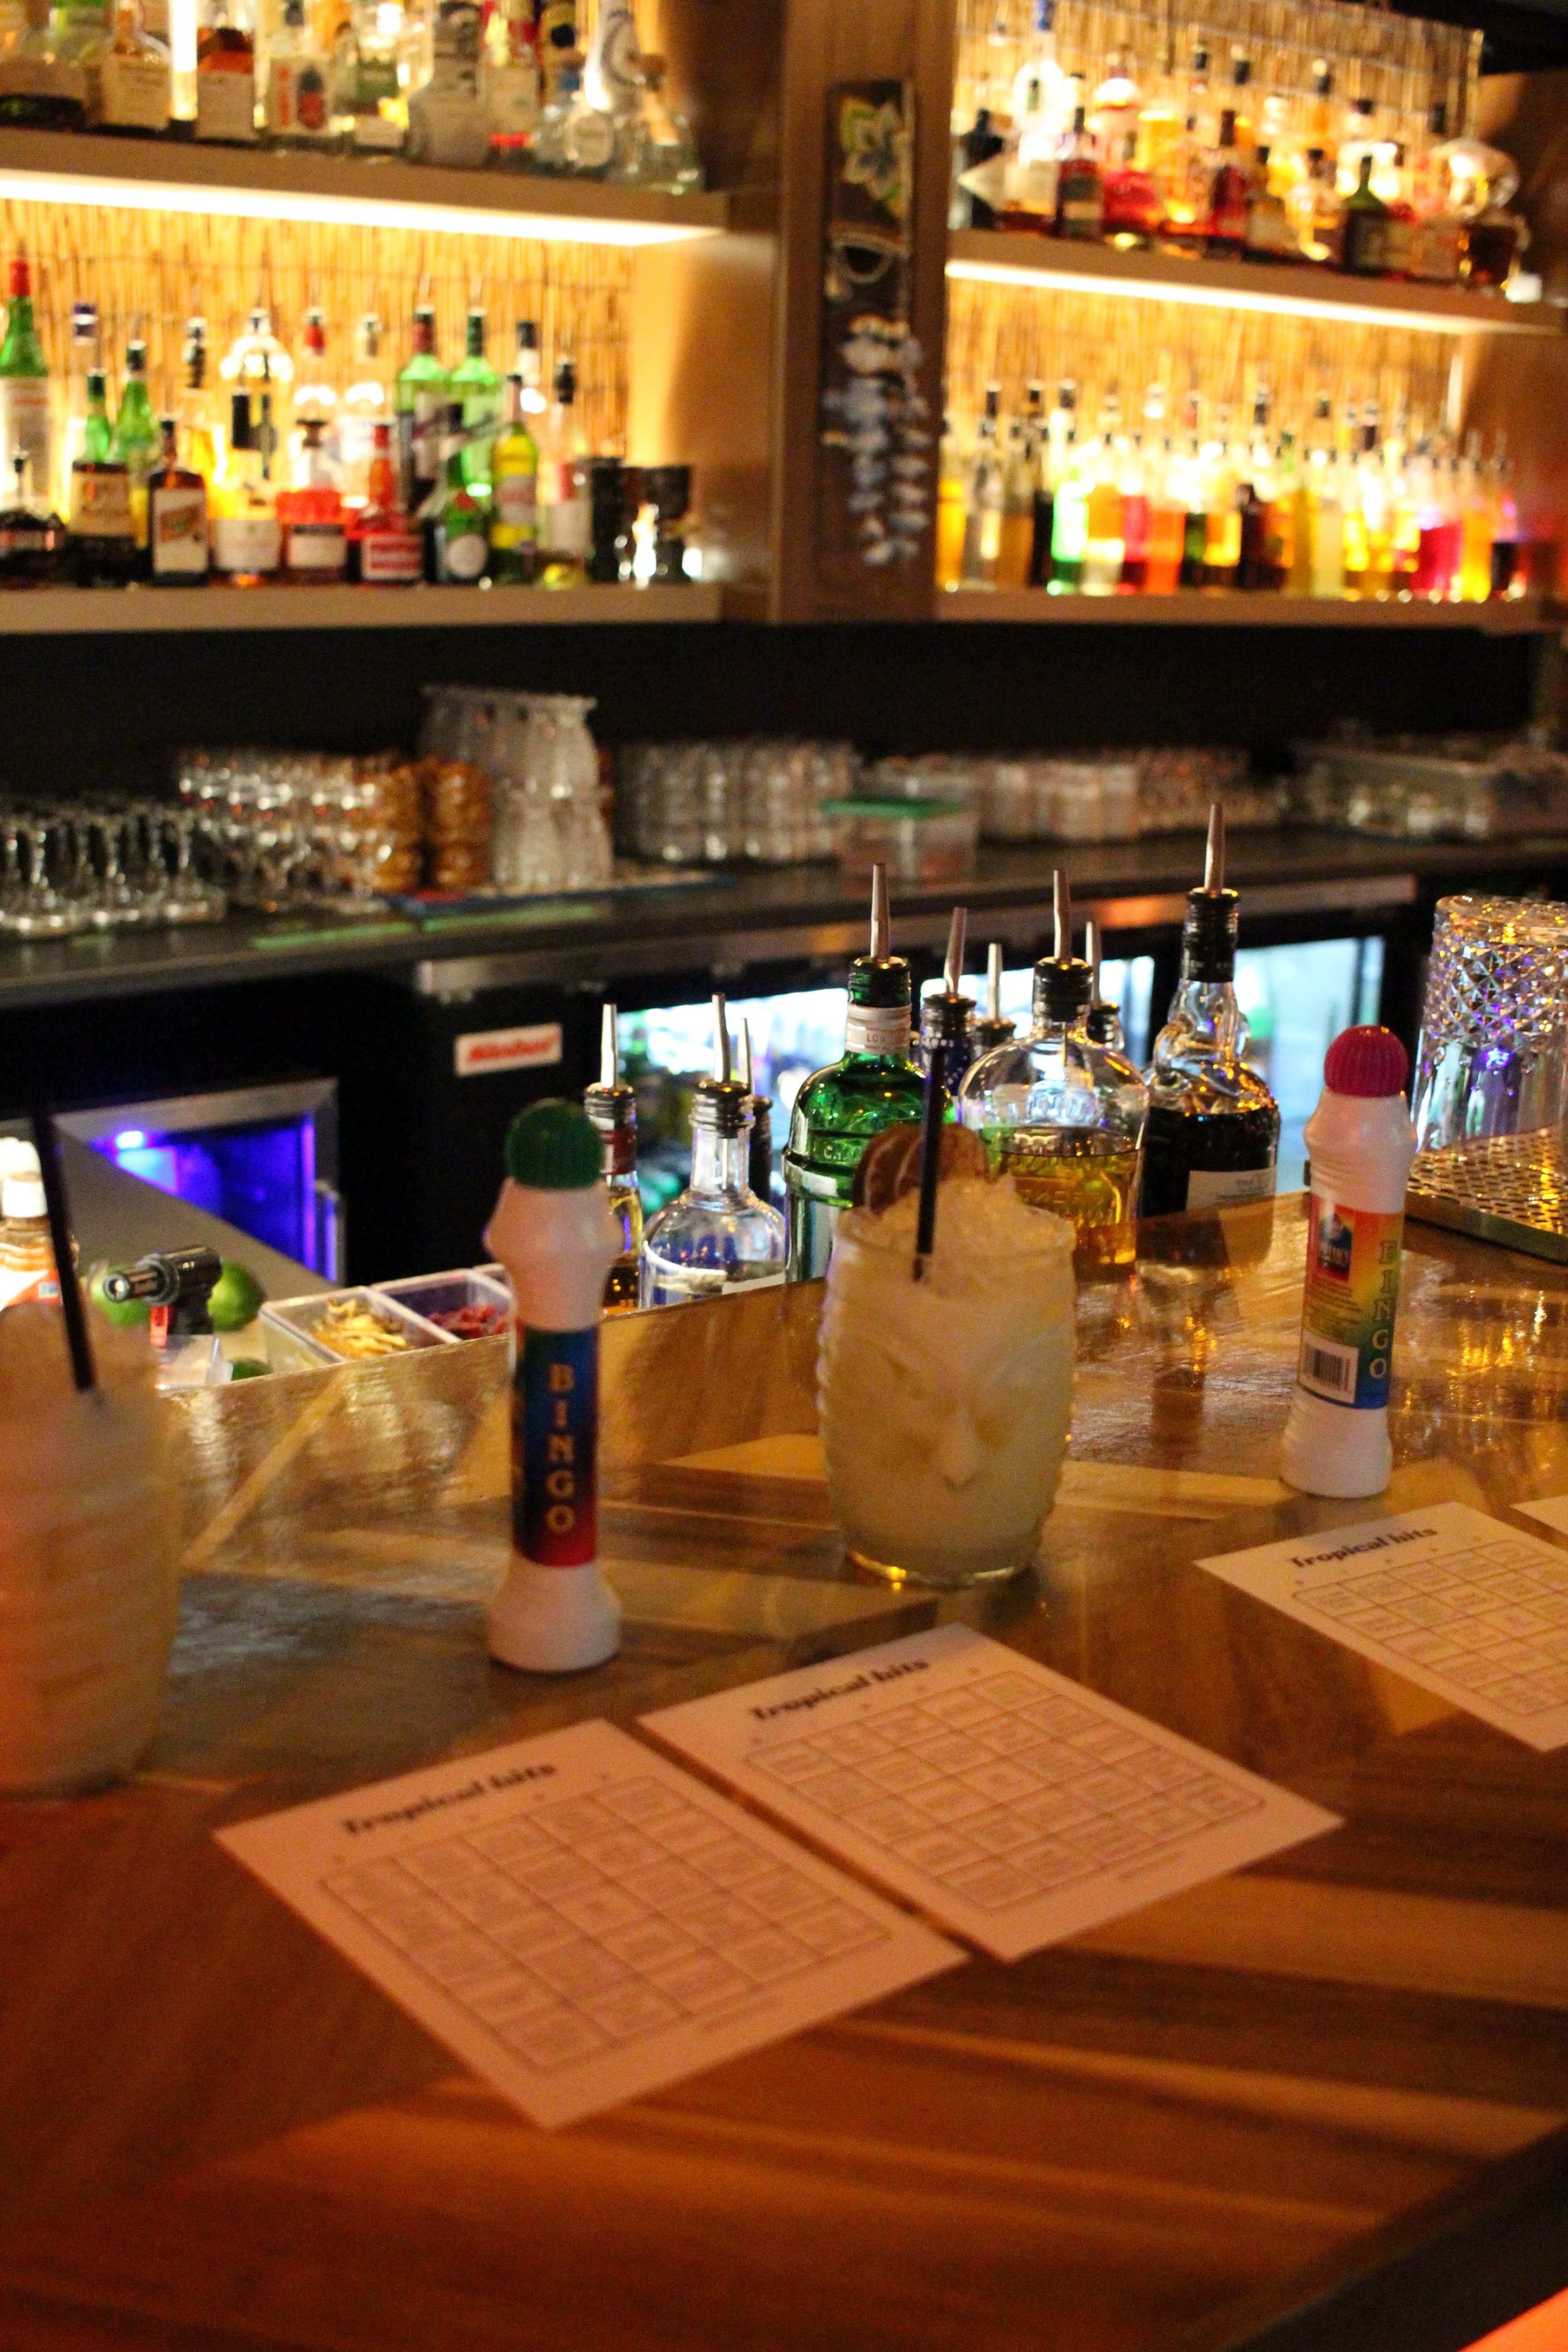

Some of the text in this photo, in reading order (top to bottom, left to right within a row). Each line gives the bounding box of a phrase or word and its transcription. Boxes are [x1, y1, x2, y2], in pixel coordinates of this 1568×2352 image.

[1368, 1240, 1400, 1378] BINGO
[546, 1363, 576, 1533] BINGO
[1288, 1536, 1389, 1567] Tropical
[751, 1675, 870, 1720] Tropical
